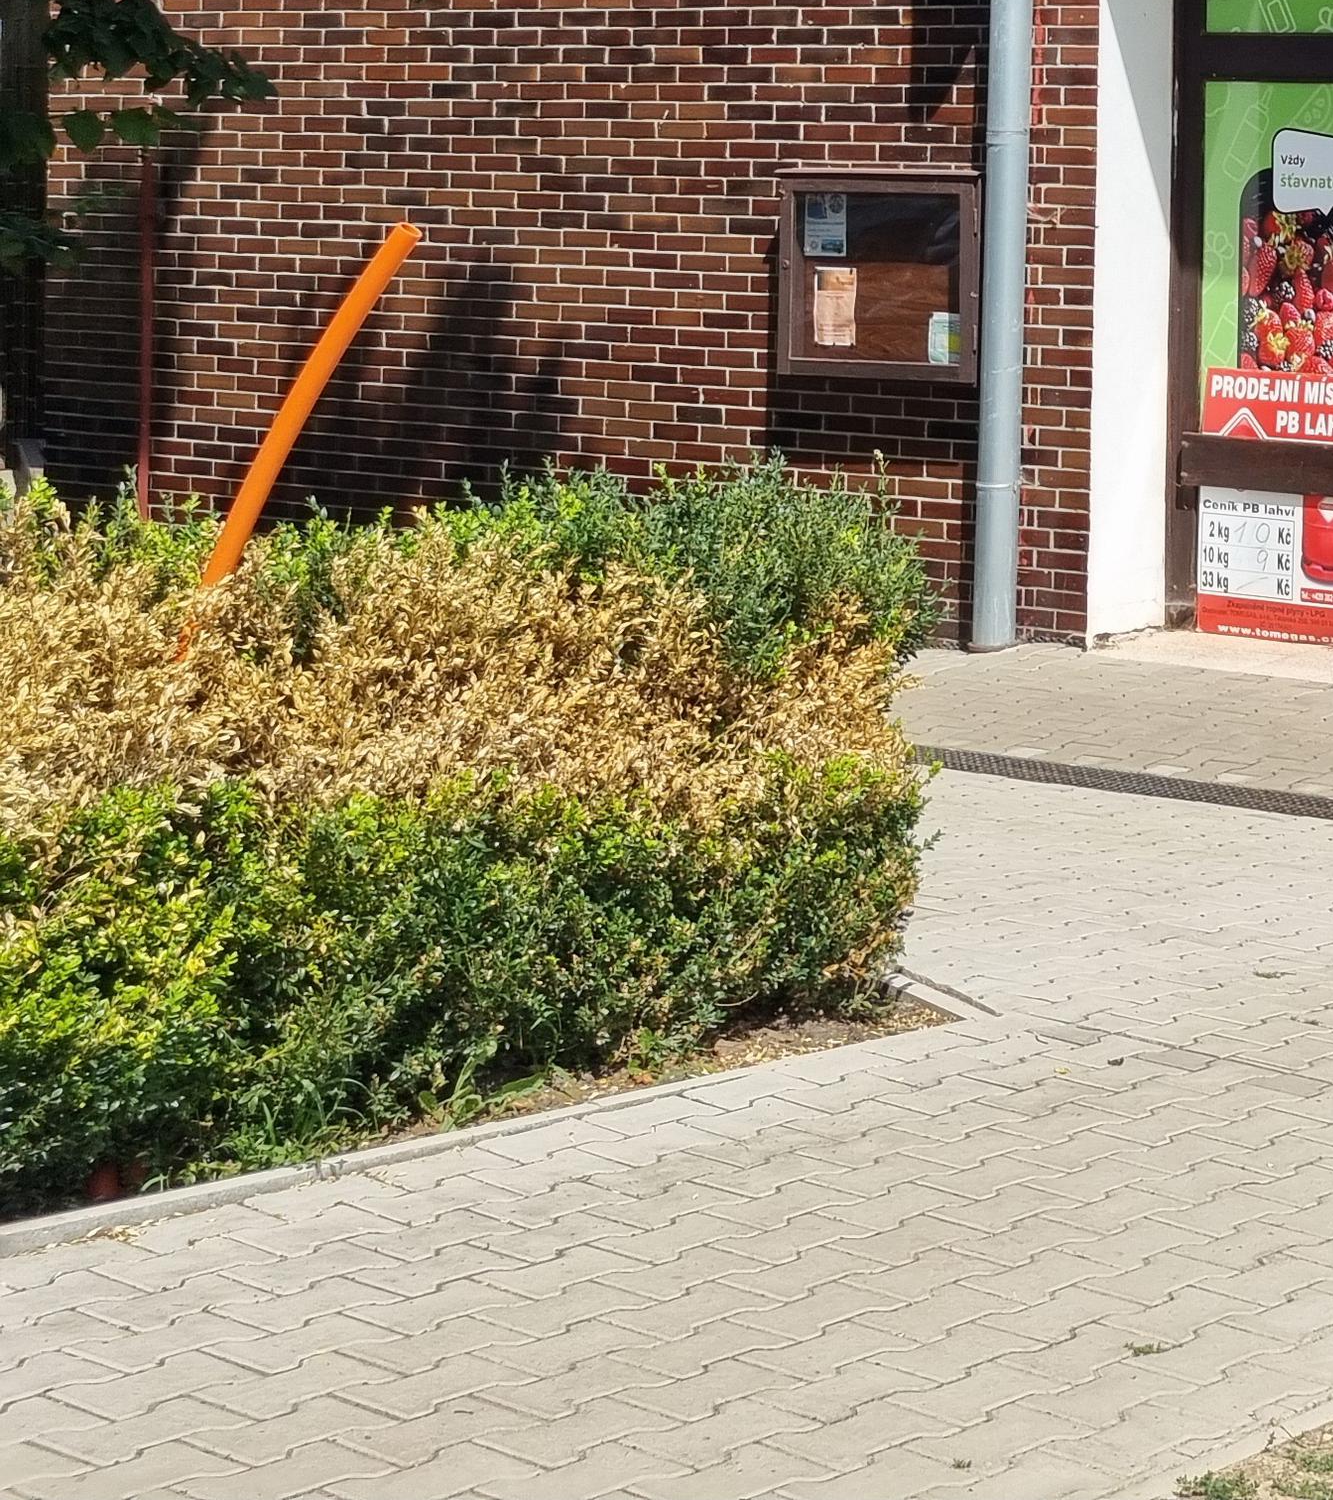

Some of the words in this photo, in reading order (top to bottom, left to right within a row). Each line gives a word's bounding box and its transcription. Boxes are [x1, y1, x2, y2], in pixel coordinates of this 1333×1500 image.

[1280, 154, 1306, 168] Vždy
[1211, 374, 1302, 404] PRODEJNÍ
[1275, 410, 1300, 434] PB
[1242, 502, 1260, 514] PB
[1264, 503, 1296, 517] lahví
[1209, 521, 1215, 538] 2
[1217, 521, 1230, 543] kg
[1277, 526, 1292, 546] Kč
[1203, 545, 1214, 563] 10
[1217, 547, 1229, 568] kg
[1277, 553, 1291, 572] Kč
[1202, 570, 1214, 588] 33
[1216, 571, 1229, 593] kg
[1276, 578, 1290, 596] Kč
